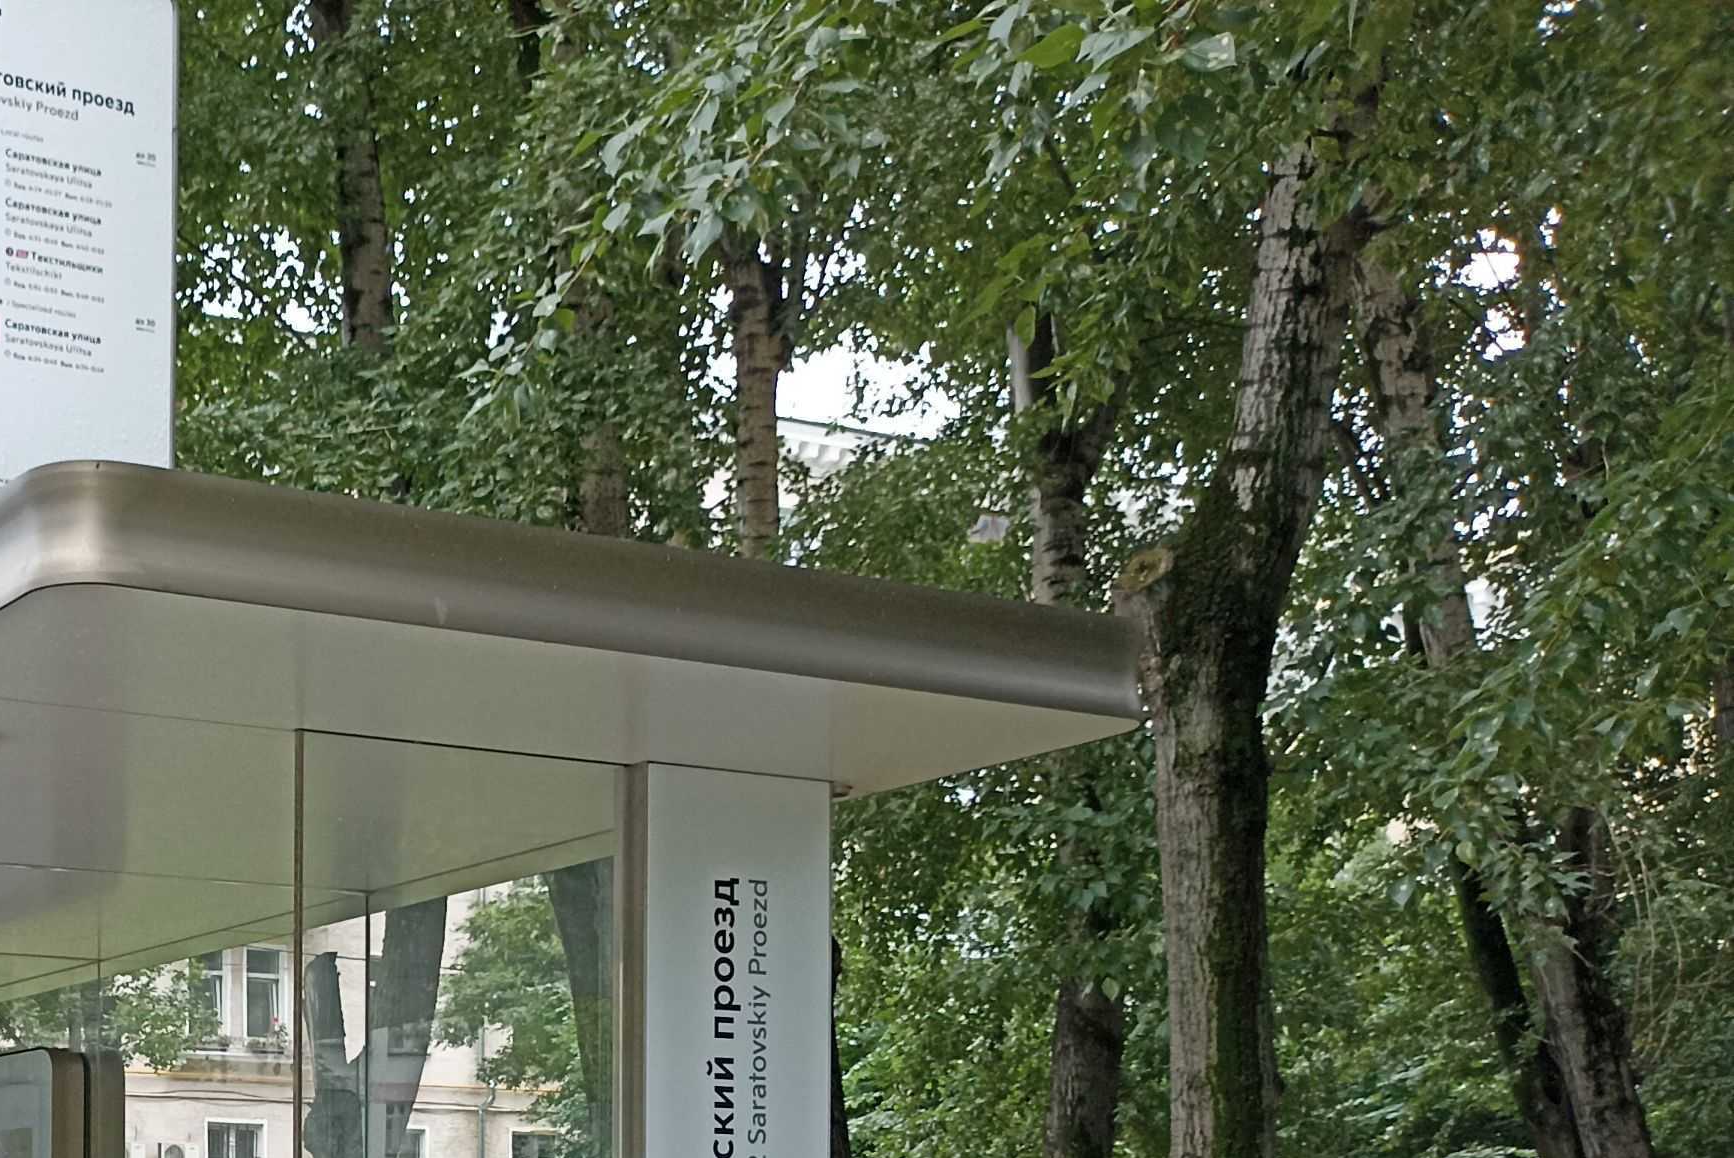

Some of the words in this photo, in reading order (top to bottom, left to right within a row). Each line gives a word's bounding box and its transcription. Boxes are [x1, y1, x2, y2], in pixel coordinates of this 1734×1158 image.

[36, 100, 79, 121] Proezd
[72, 88, 135, 116] проезд
[5, 148, 70, 170] Саратовская
[72, 165, 102, 178] улица
[5, 197, 70, 220] Саратовская
[72, 213, 102, 226] улица
[32, 252, 104, 275] Текстильщики
[5, 318, 69, 338] Саратовская
[71, 332, 102, 345] улица
[748, 879, 768, 976] Proezd
[713, 877, 742, 1040] проезд
[747, 985, 771, 1145] Saratovskiy
